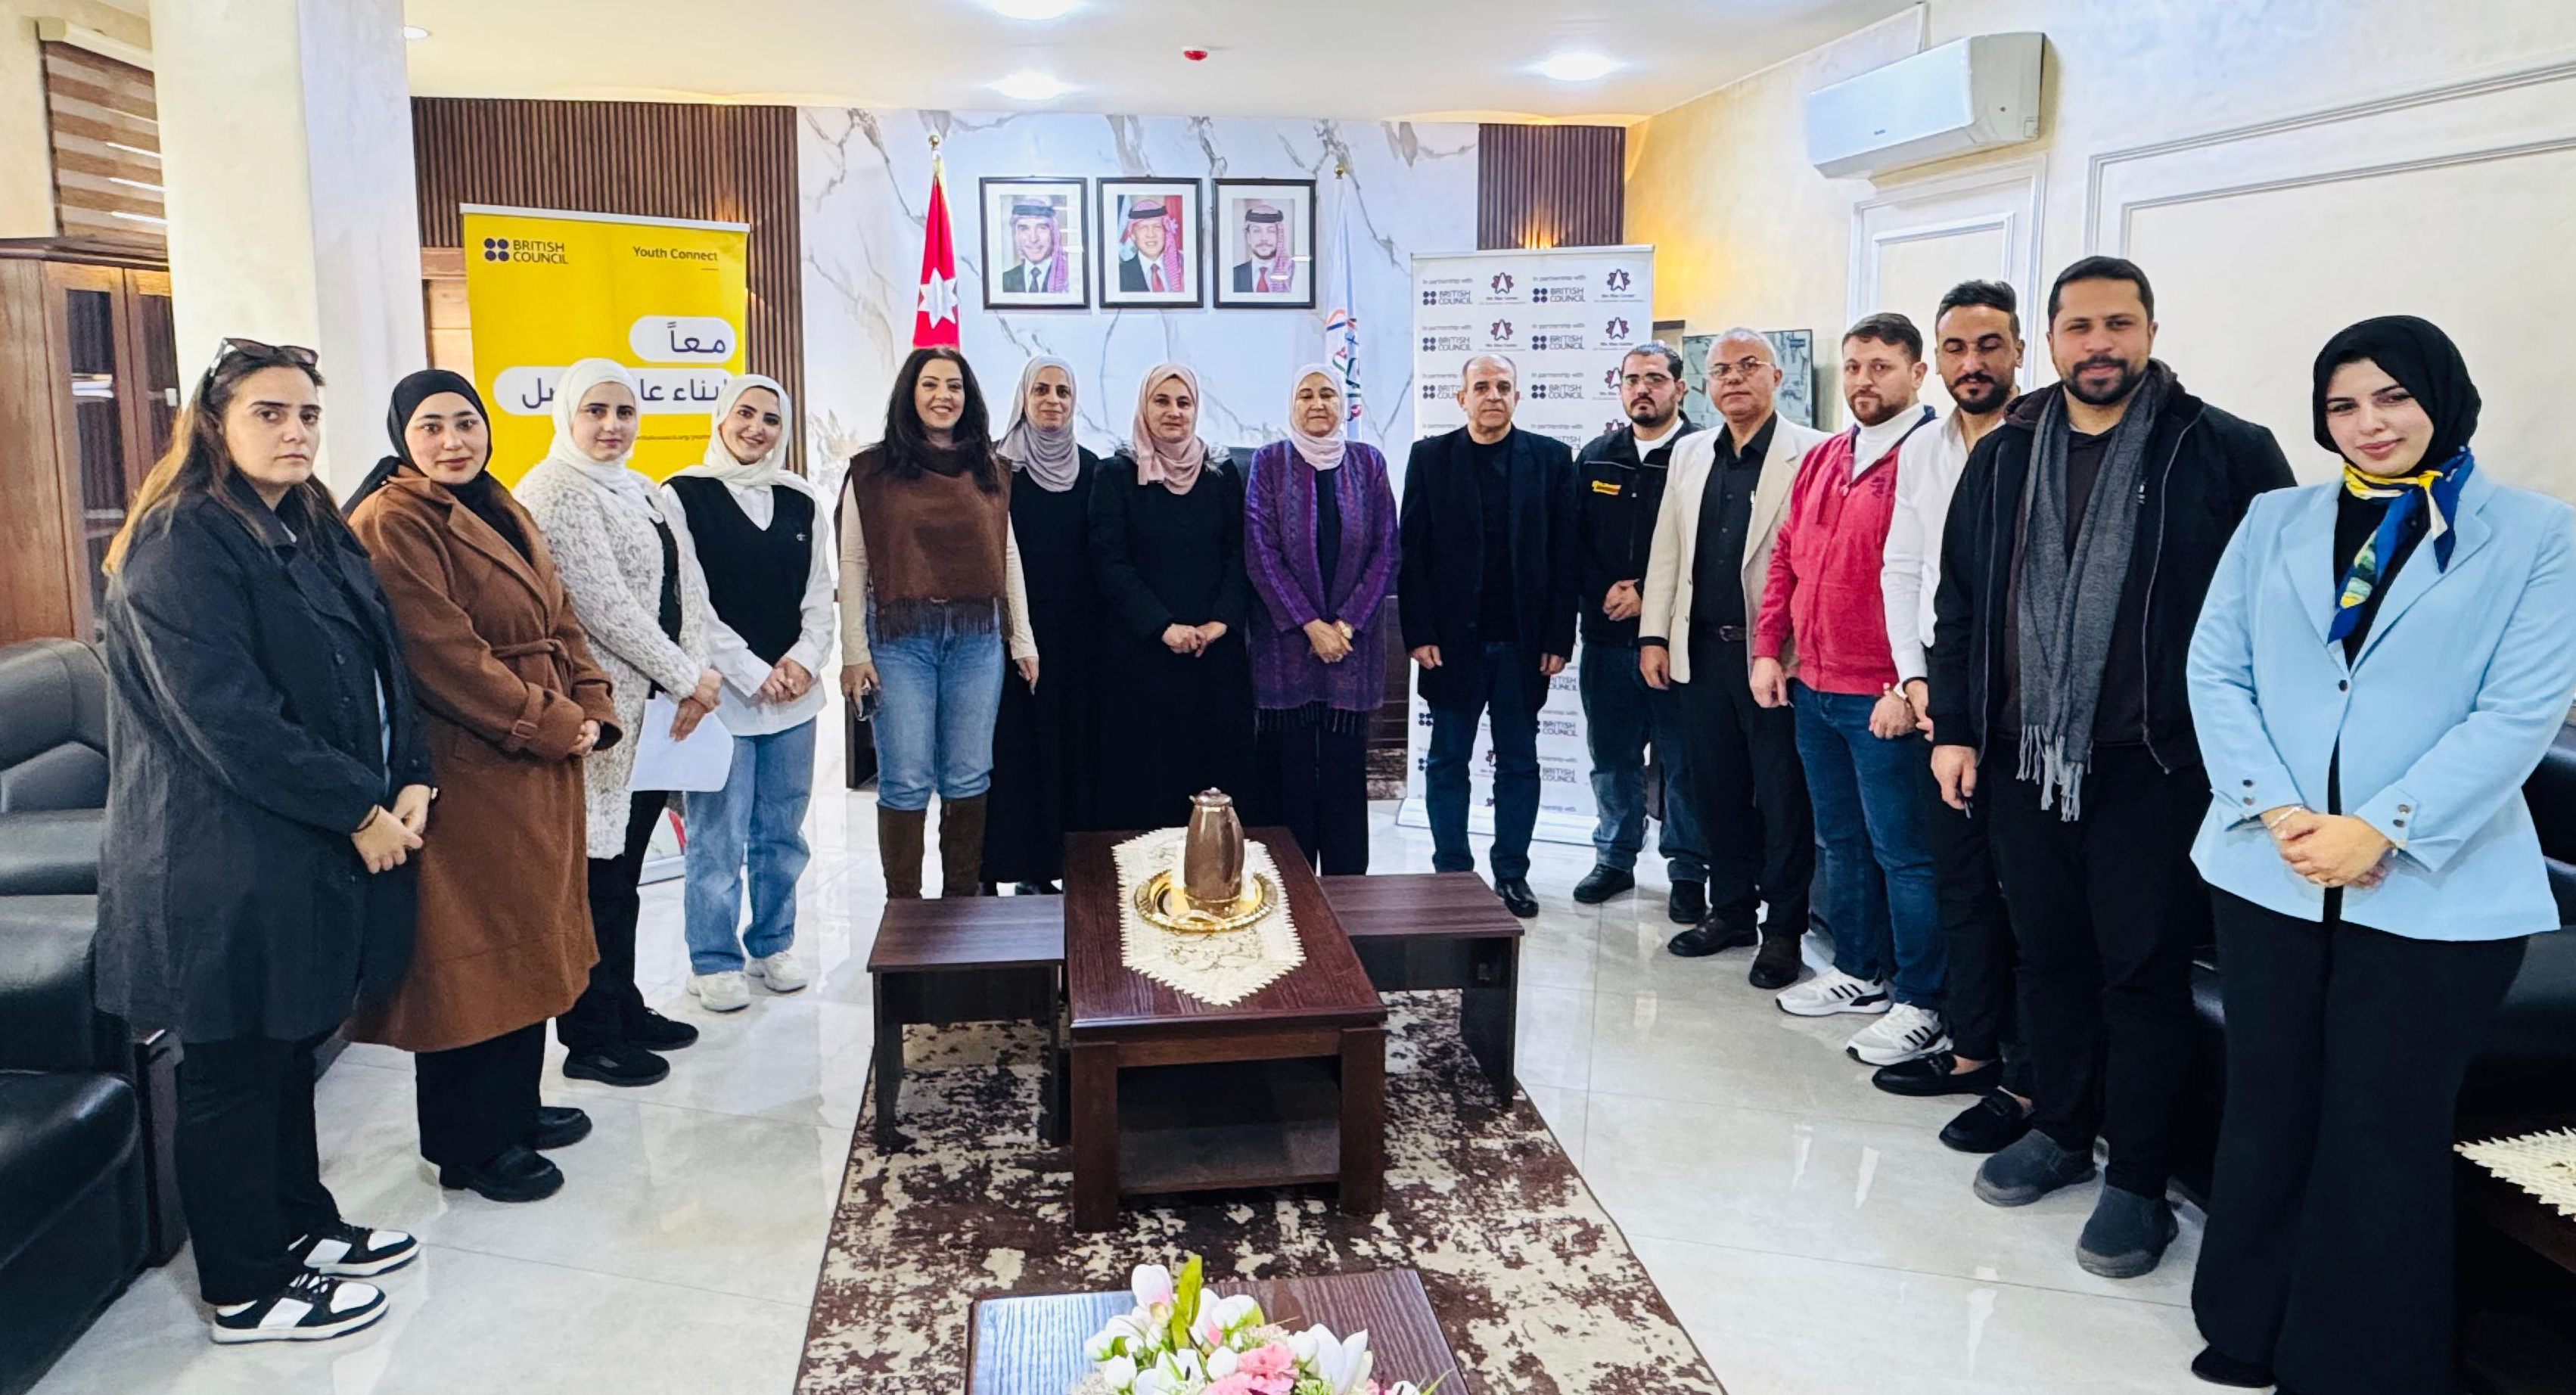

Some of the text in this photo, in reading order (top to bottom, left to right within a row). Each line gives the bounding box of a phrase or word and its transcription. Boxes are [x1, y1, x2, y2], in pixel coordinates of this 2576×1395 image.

[513, 240, 564, 253] BRITISH
[513, 251, 569, 265] COUNCIL
[632, 246, 718, 262] Youth Connect
